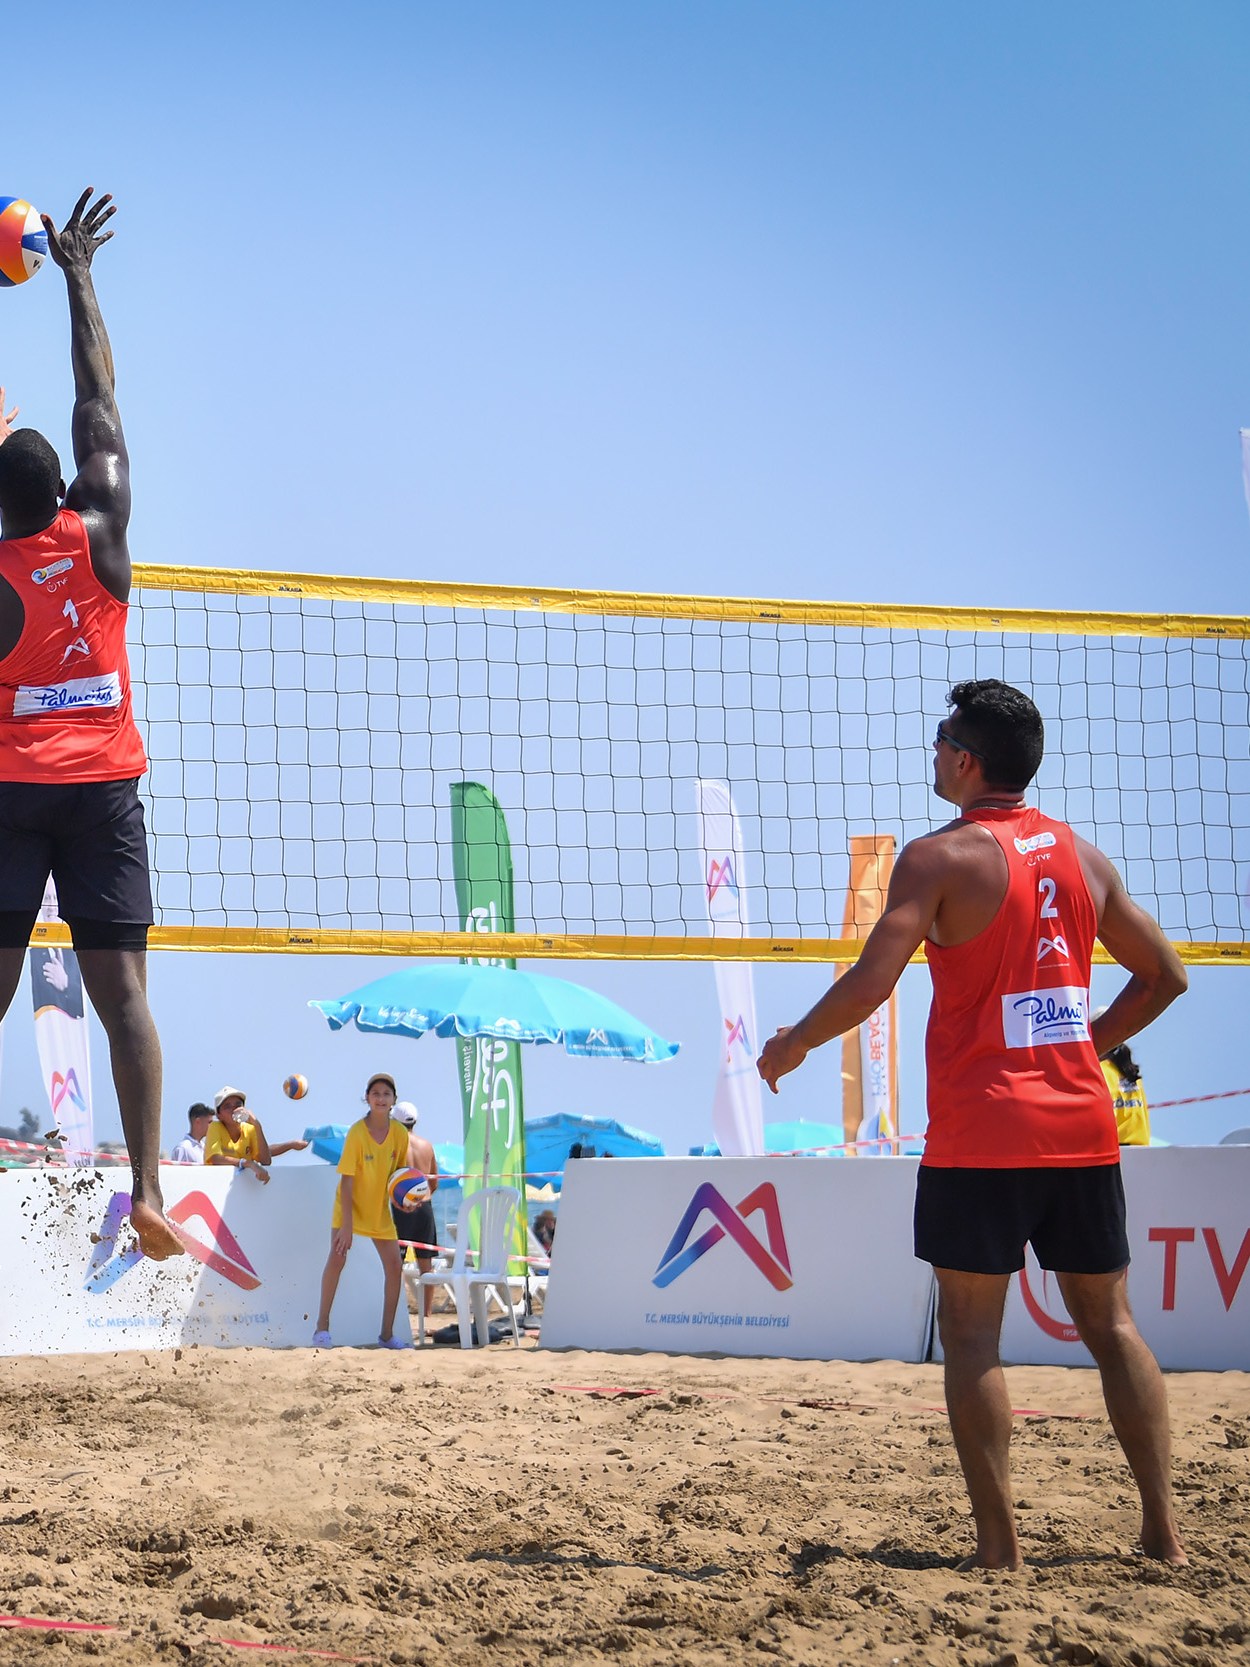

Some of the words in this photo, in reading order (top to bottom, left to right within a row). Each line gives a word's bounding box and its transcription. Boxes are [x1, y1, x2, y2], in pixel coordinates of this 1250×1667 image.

[62, 599, 79, 628] 1
[29, 686, 114, 711] Palmcity
[1038, 877, 1058, 919] 2
[645, 1313, 658, 1324] T.C.
[659, 1311, 690, 1324] MERSİN
[692, 1311, 743, 1328] BÜYÜKŞEHİR
[745, 1313, 790, 1328] BELEDİYESİ
